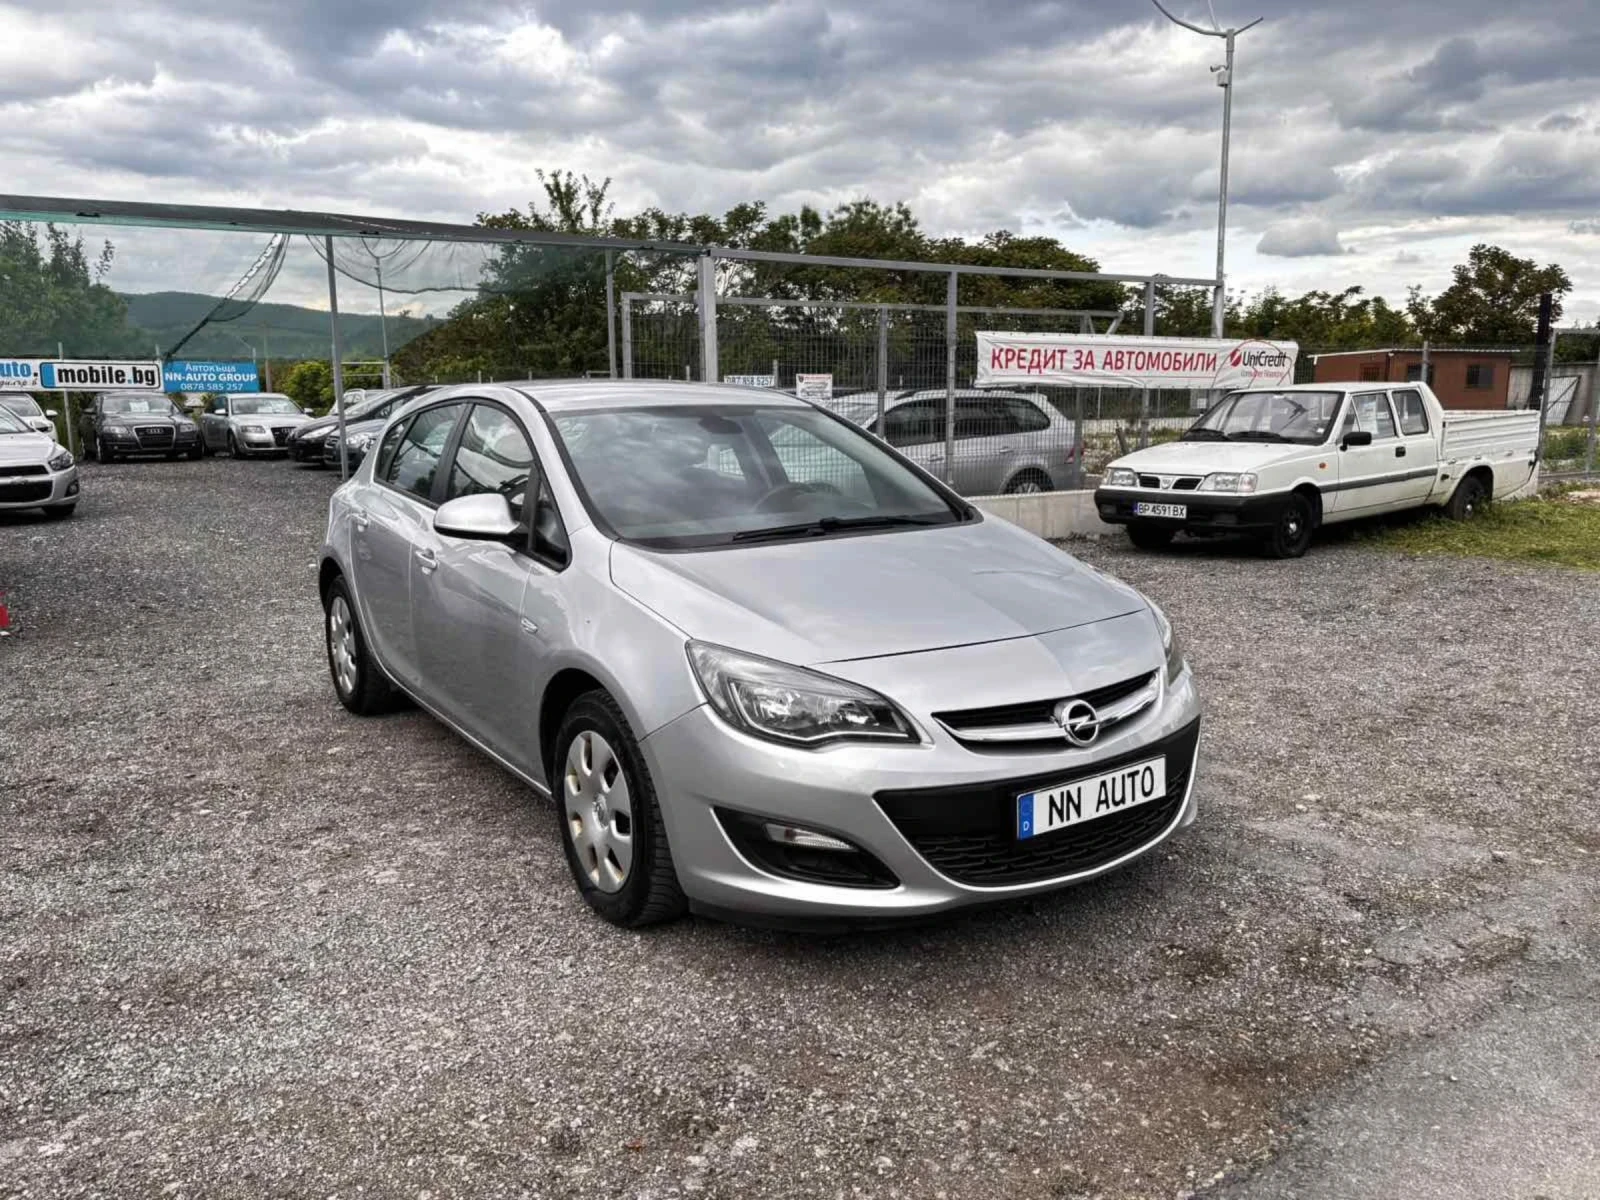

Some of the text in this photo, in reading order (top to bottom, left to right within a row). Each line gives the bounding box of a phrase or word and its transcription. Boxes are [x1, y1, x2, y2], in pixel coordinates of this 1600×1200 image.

[991, 348, 1217, 374] КРЕДИТ ЗА АВТОМОБИЛИ
[1243, 351, 1286, 367] UniCredit
[0, 361, 155, 386] uto. mobile.bg
[165, 372, 257, 382] NN-AUTO GROUP
[180, 383, 243, 391] 0878 585 257
[1151, 504, 1171, 516] 4591
[1048, 766, 1154, 827] NN AUTO
[1023, 820, 1030, 832] D
